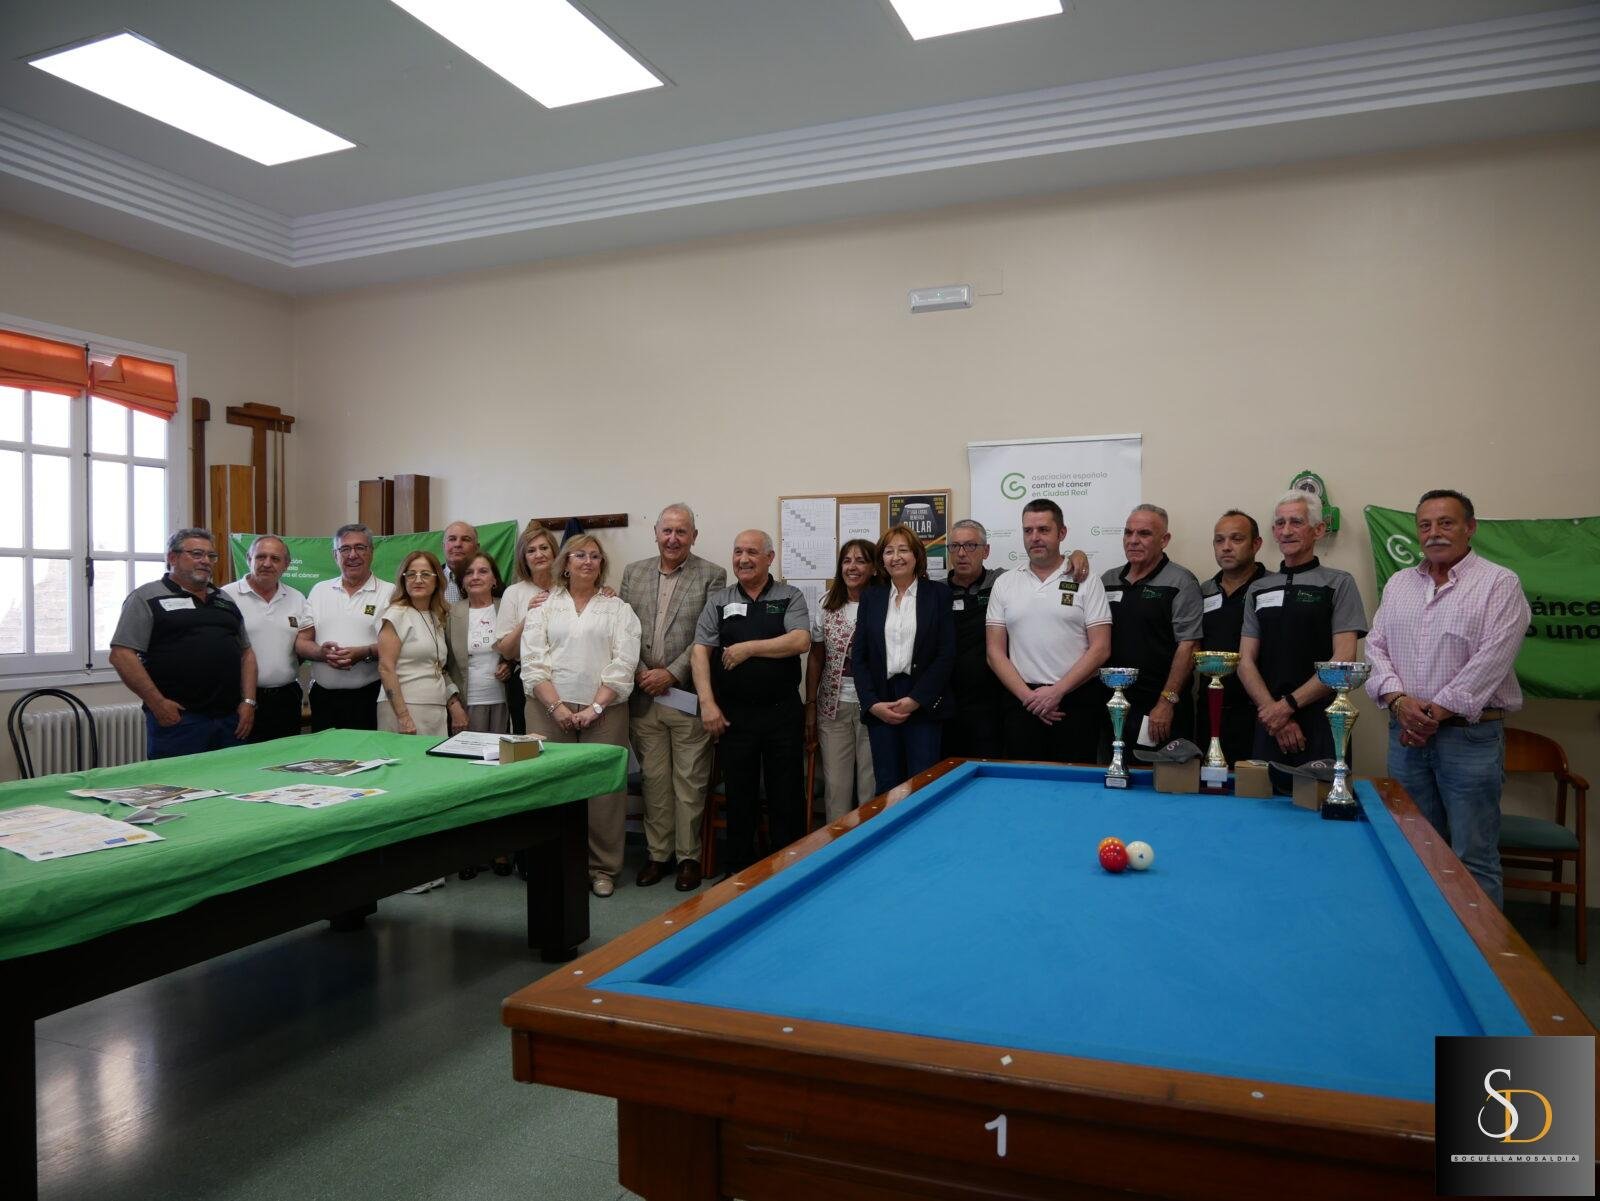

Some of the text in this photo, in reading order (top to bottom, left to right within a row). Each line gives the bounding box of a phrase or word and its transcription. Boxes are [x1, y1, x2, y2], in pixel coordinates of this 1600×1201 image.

[1031, 471, 1108, 481] asociación española
[1042, 489, 1070, 497] Ciudad
[1071, 488, 1088, 496] Real
[1531, 595, 1600, 616] ánce
[1546, 624, 1600, 640] uno
[984, 1113, 1007, 1157] 1
